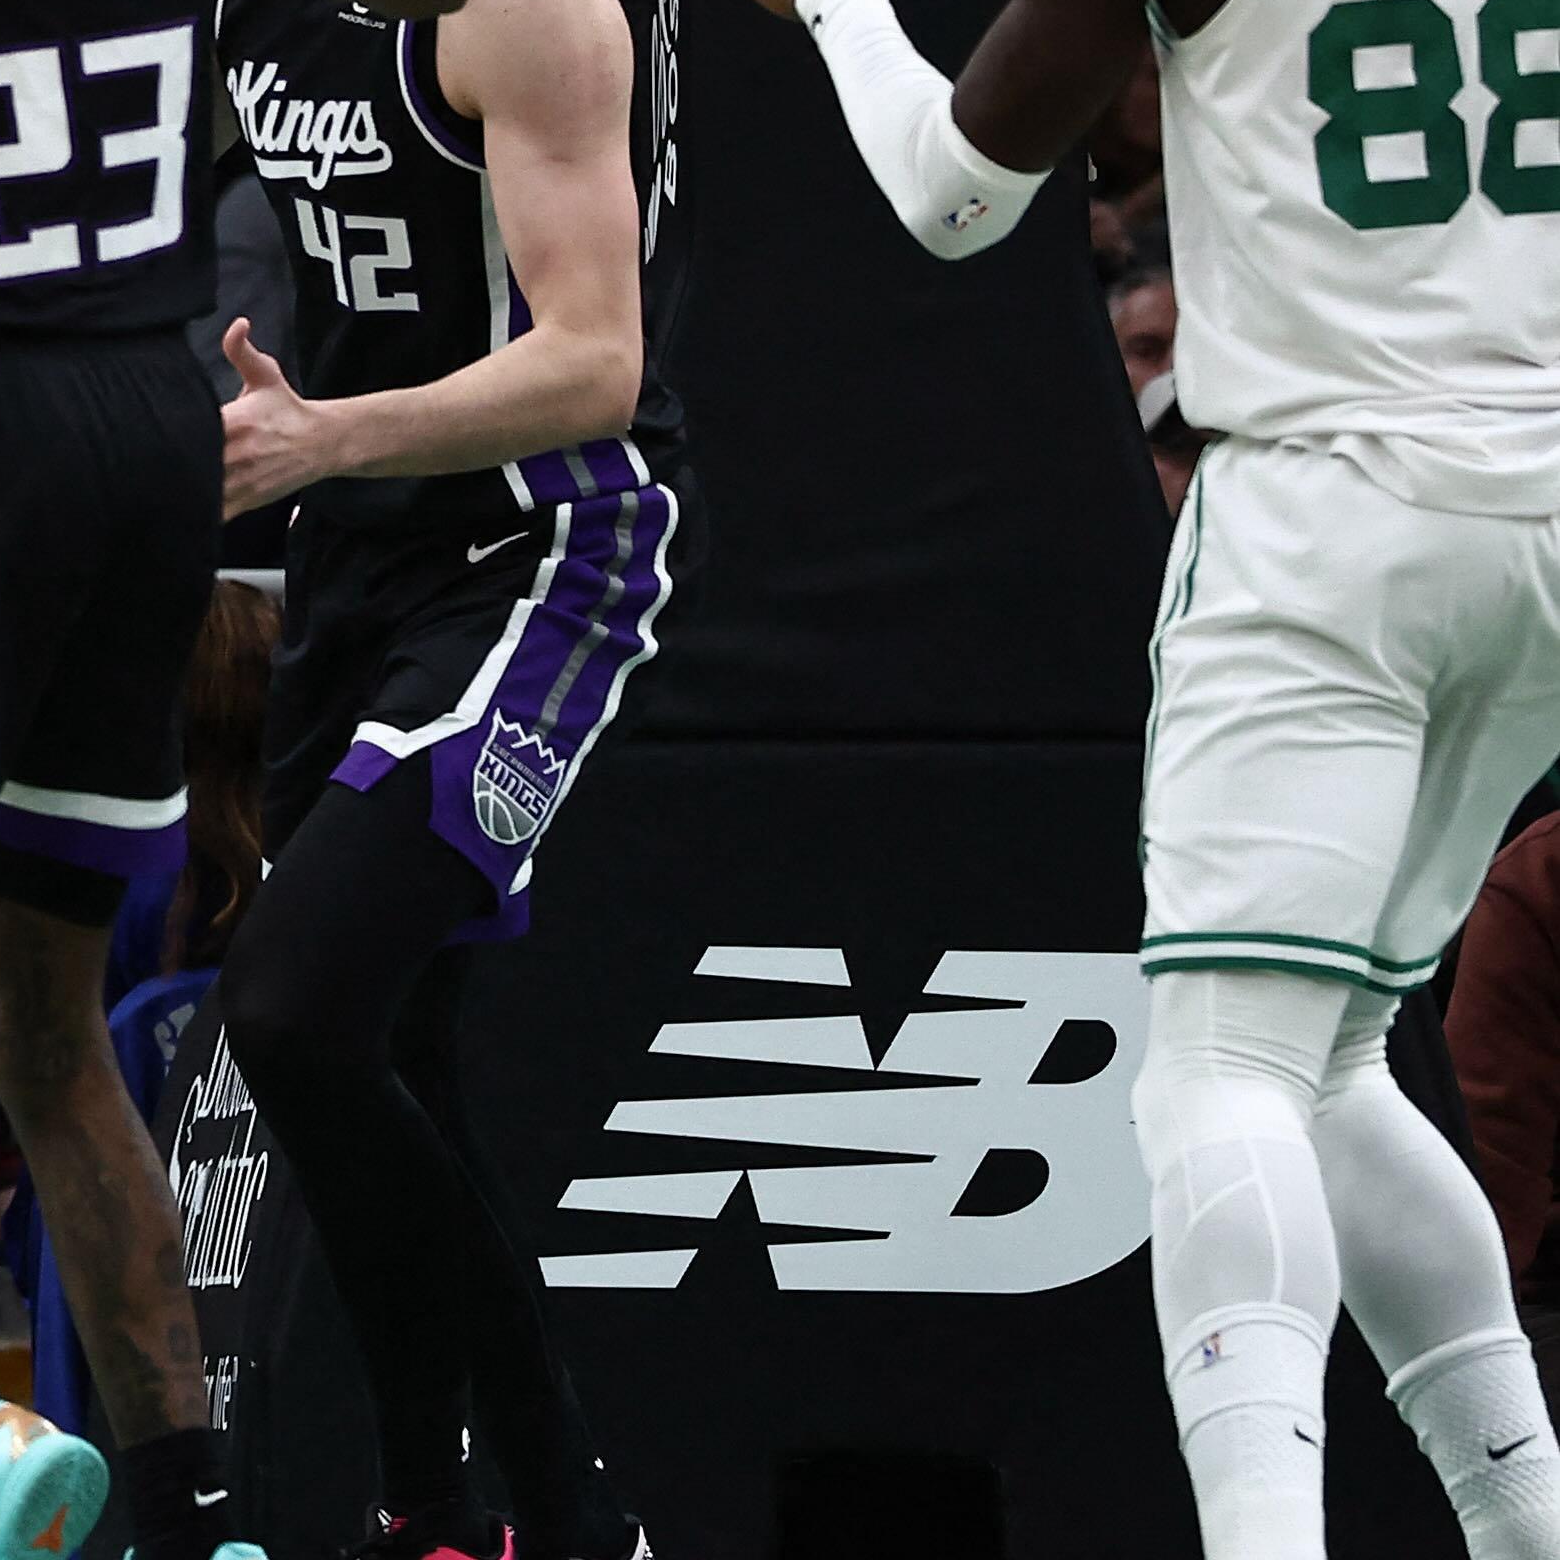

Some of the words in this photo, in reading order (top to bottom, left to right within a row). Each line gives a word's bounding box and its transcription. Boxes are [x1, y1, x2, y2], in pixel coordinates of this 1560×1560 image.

[226, 59, 394, 192] Kings
[294, 197, 421, 313] 42
[481, 754, 548, 821] KINGS
